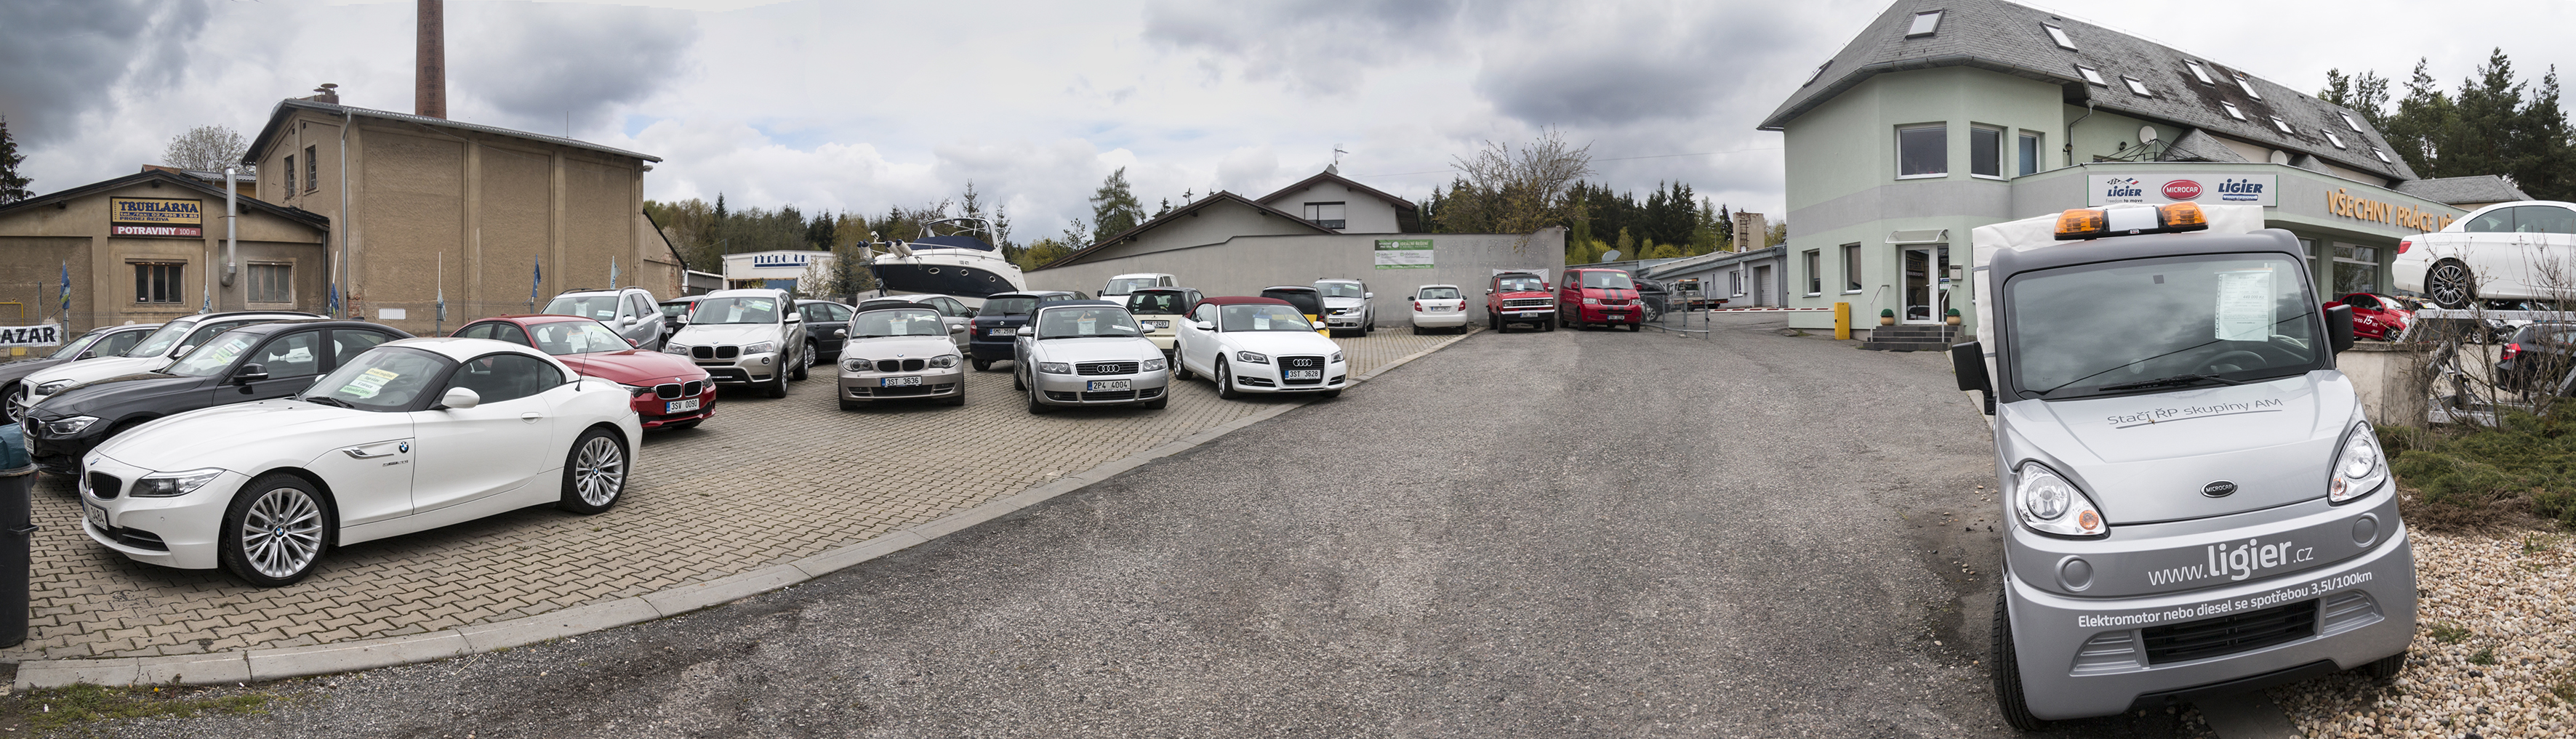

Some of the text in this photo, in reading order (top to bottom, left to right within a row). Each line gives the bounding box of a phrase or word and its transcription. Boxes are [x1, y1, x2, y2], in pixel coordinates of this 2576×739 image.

[119, 201, 198, 212] TRUHLÁRNA
[2327, 187, 2457, 232] VŠECHNY PRÁCE VŠ
[118, 226, 176, 235] POTRAVINY
[2363, 315, 2374, 325] 15
[0, 327, 56, 344] AZAR
[671, 400, 698, 411] 3SV 0090
[2107, 398, 2284, 425] Stačí ŘP skupiny AM
[2205, 484, 2233, 493] MICROCAR
[2148, 538, 2314, 586] www.ligier.cz
[2078, 572, 2372, 628] Elektromotor nebo diesel se spotřebou 3,5l/100km
